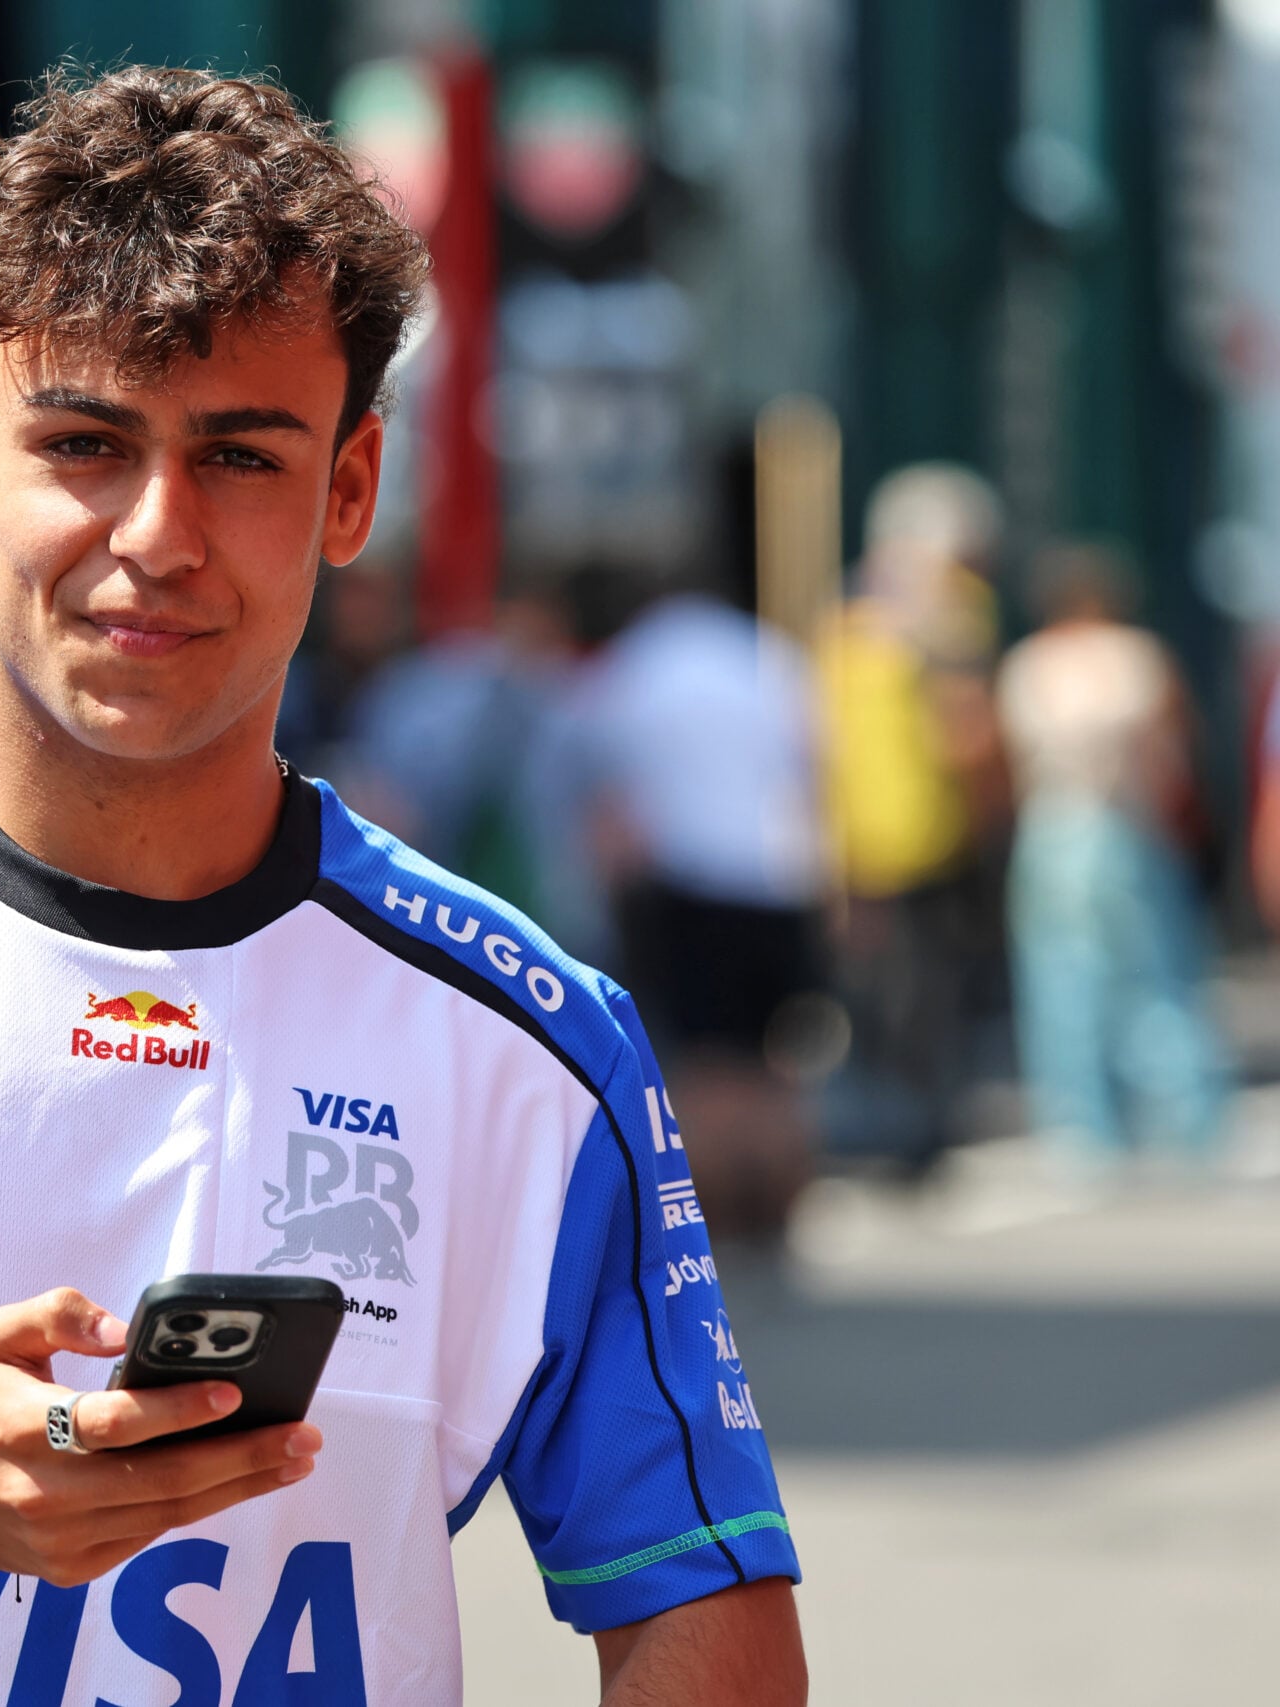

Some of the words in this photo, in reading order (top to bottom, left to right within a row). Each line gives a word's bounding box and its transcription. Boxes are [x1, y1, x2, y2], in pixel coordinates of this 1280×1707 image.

[383, 884, 565, 1013] HUGO
[71, 1028, 138, 1063] Red
[143, 1036, 210, 1070] Bull
[292, 1087, 400, 1141] VISA
[362, 1299, 398, 1323] App
